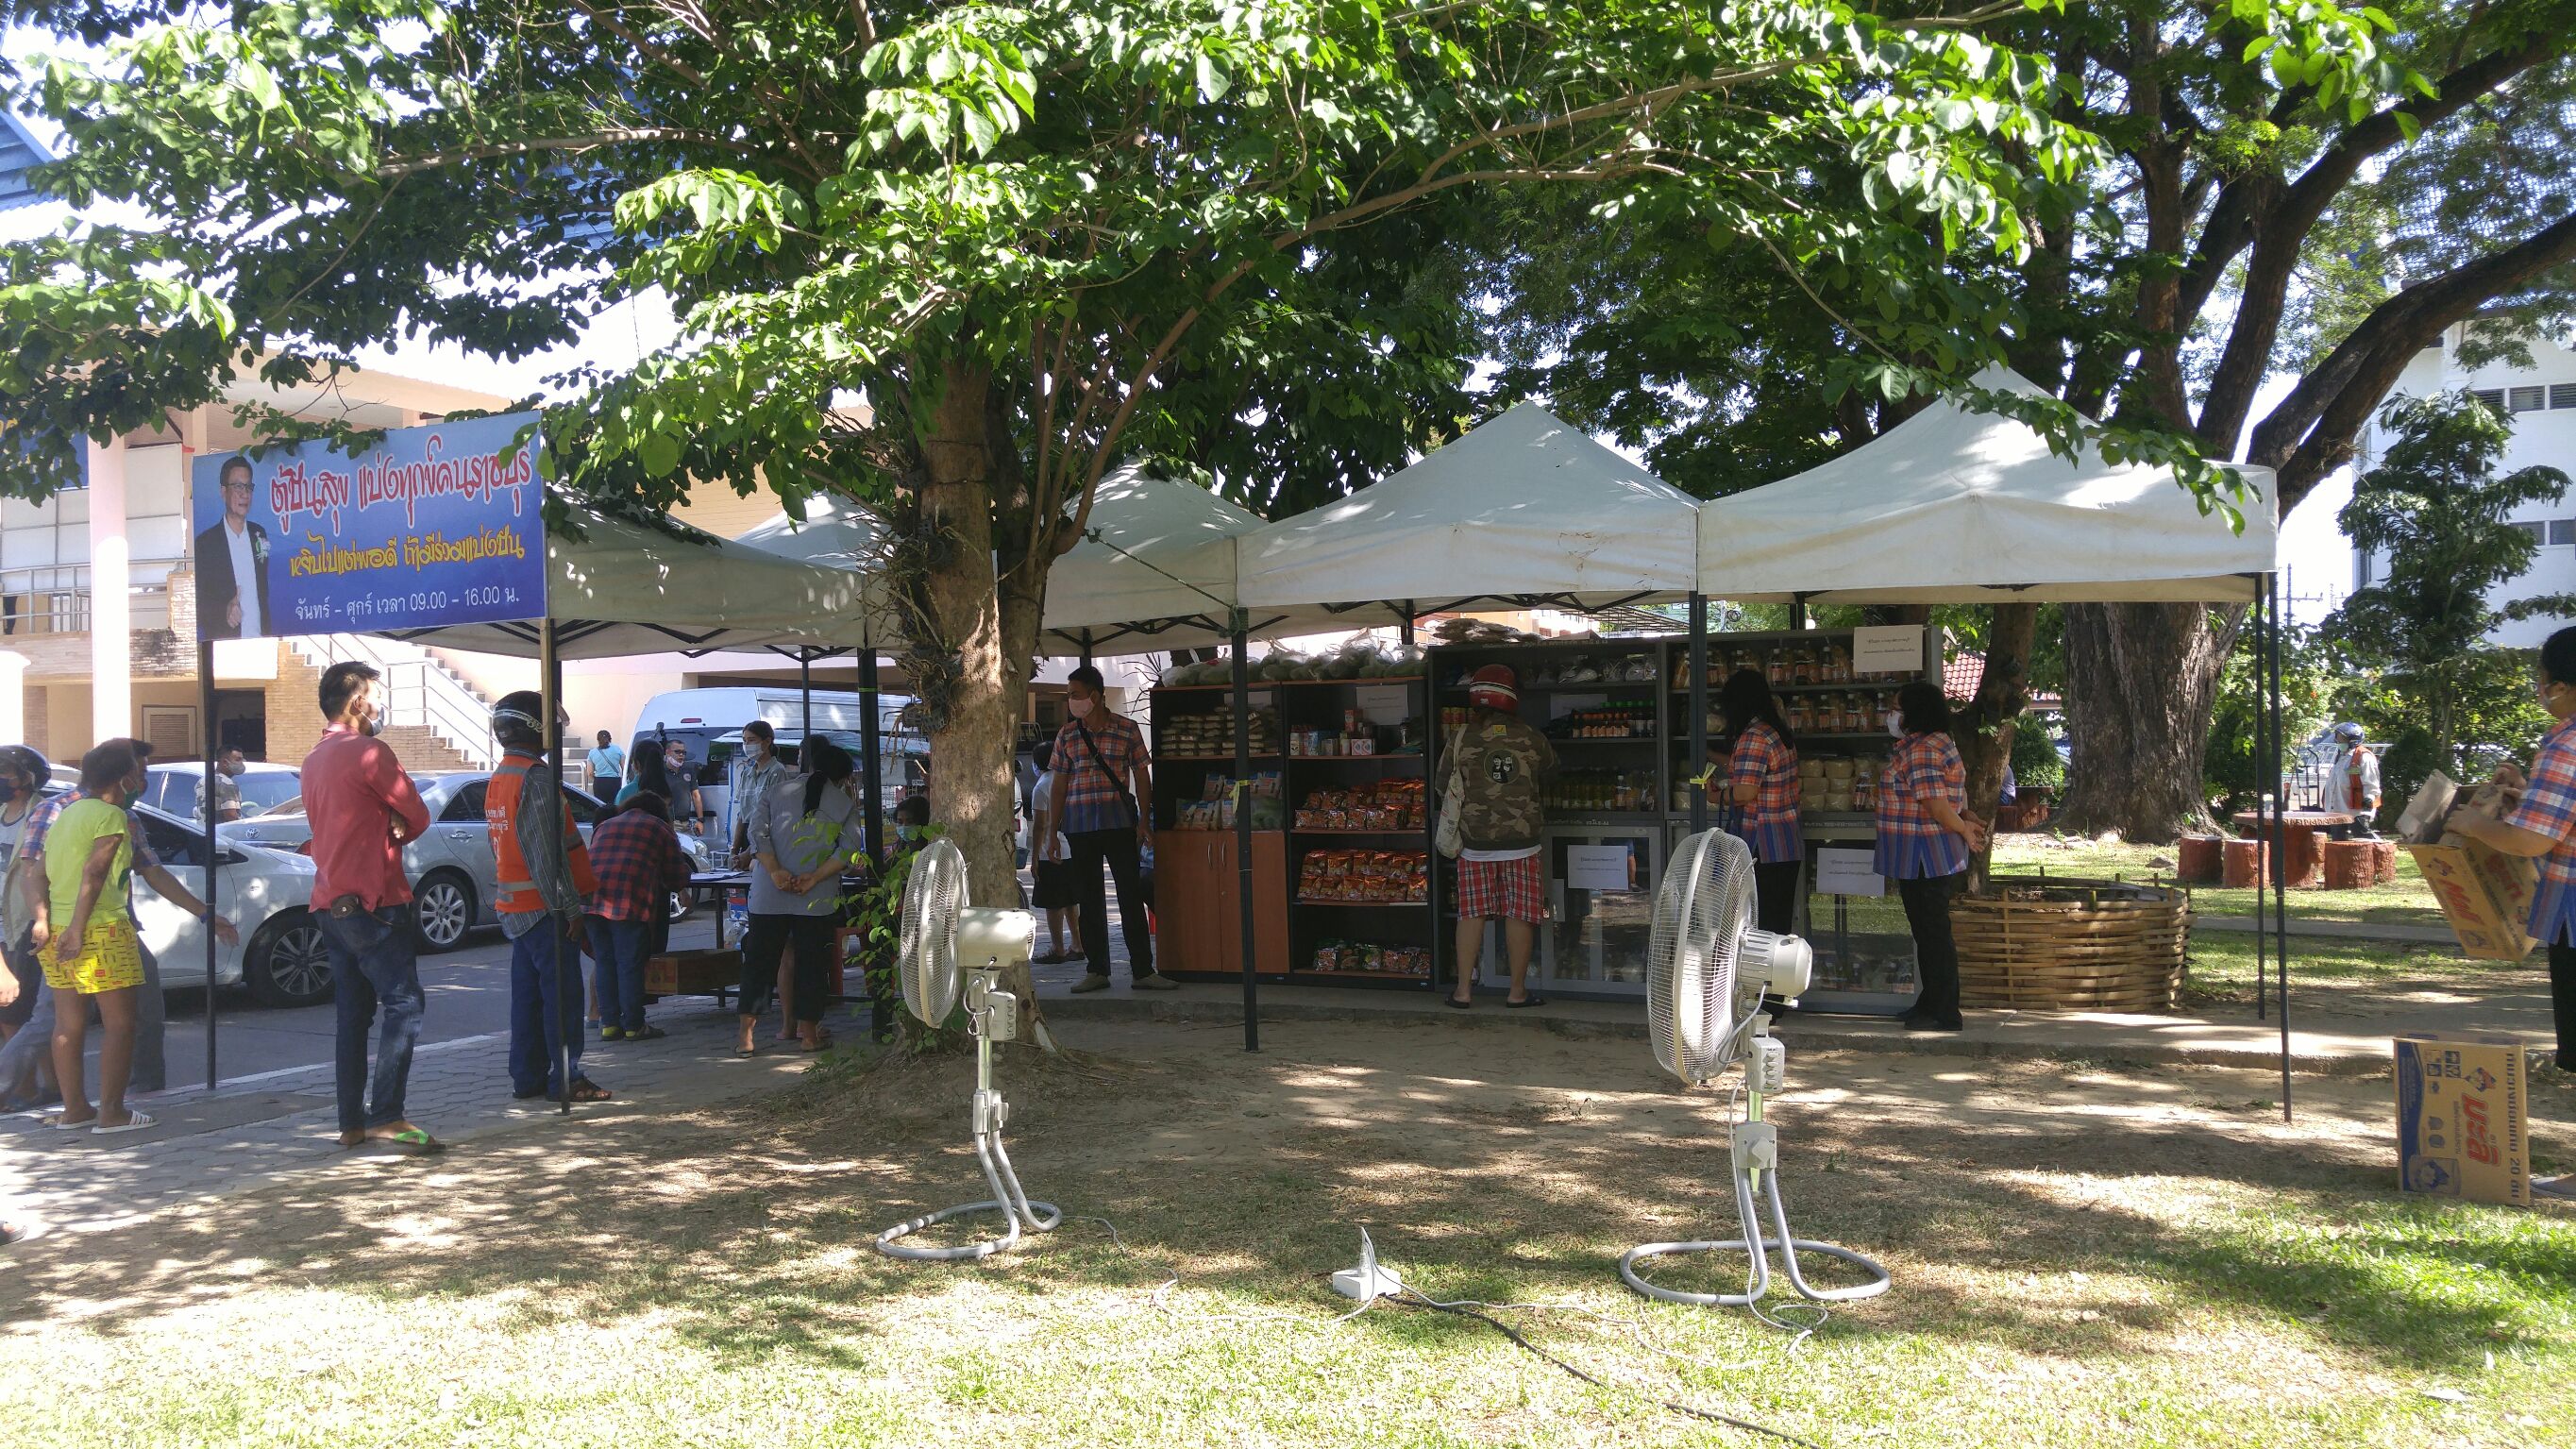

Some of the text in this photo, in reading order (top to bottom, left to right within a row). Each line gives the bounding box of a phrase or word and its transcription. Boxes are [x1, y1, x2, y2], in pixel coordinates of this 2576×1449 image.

[271, 433, 531, 535] ตู้ปันสุข แบ่งทุกข์คนราชบุร
[295, 596, 330, 620] จันทร์
[346, 592, 373, 624] ศุกร์
[377, 597, 406, 614] เวลา
[410, 590, 446, 611] 09.00
[464, 585, 500, 607] 16.00
[504, 587, 520, 602] น.
[2510, 1157, 2521, 1174] 20
